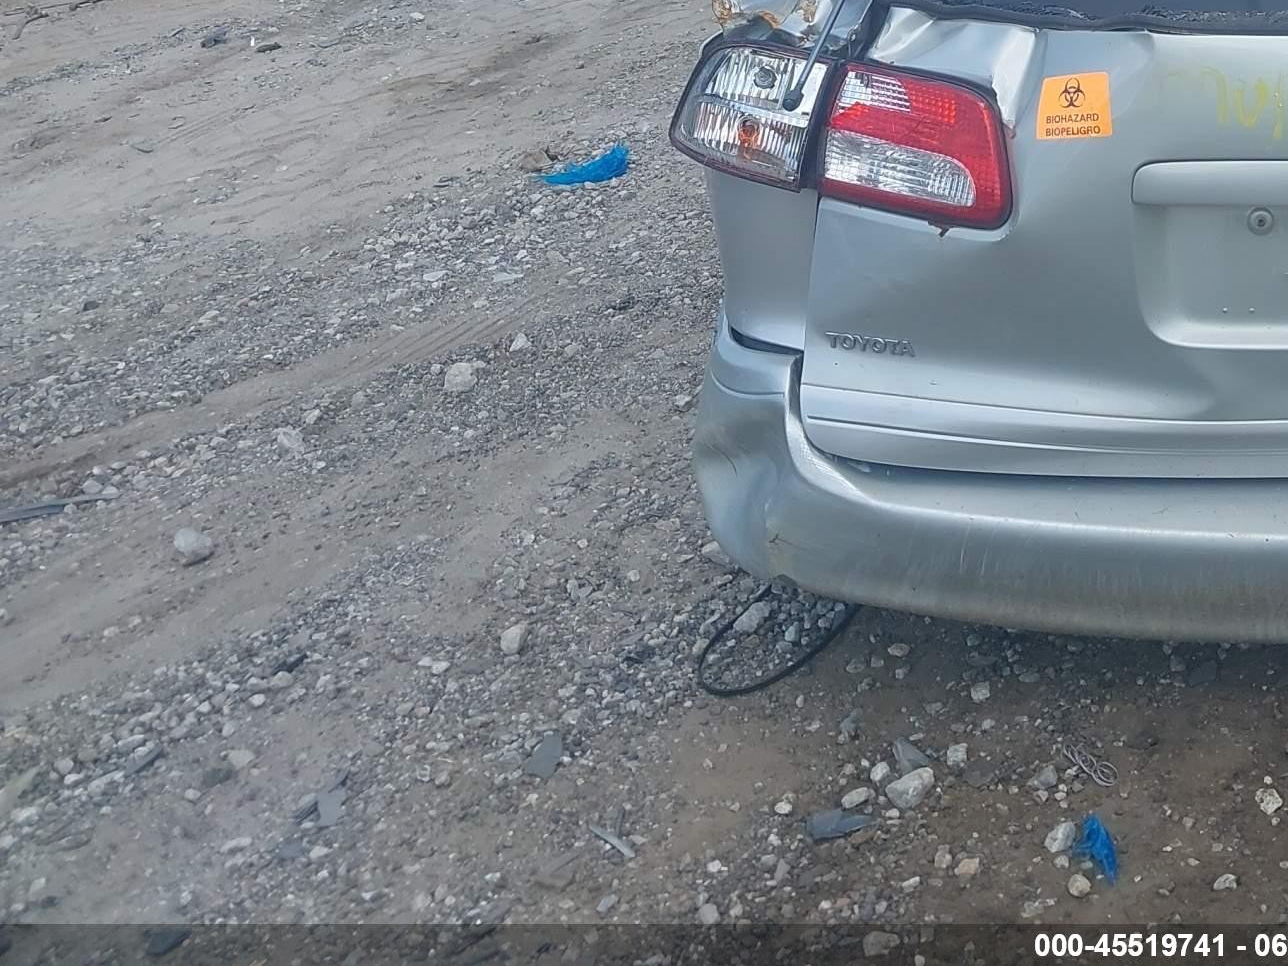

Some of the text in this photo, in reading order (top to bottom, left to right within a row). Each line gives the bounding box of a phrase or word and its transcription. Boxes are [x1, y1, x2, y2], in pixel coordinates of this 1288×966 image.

[1045, 113, 1100, 124] BIOHAZARD
[1045, 125, 1101, 137] BIOPELIGRO
[825, 331, 916, 358] TOYOTA
